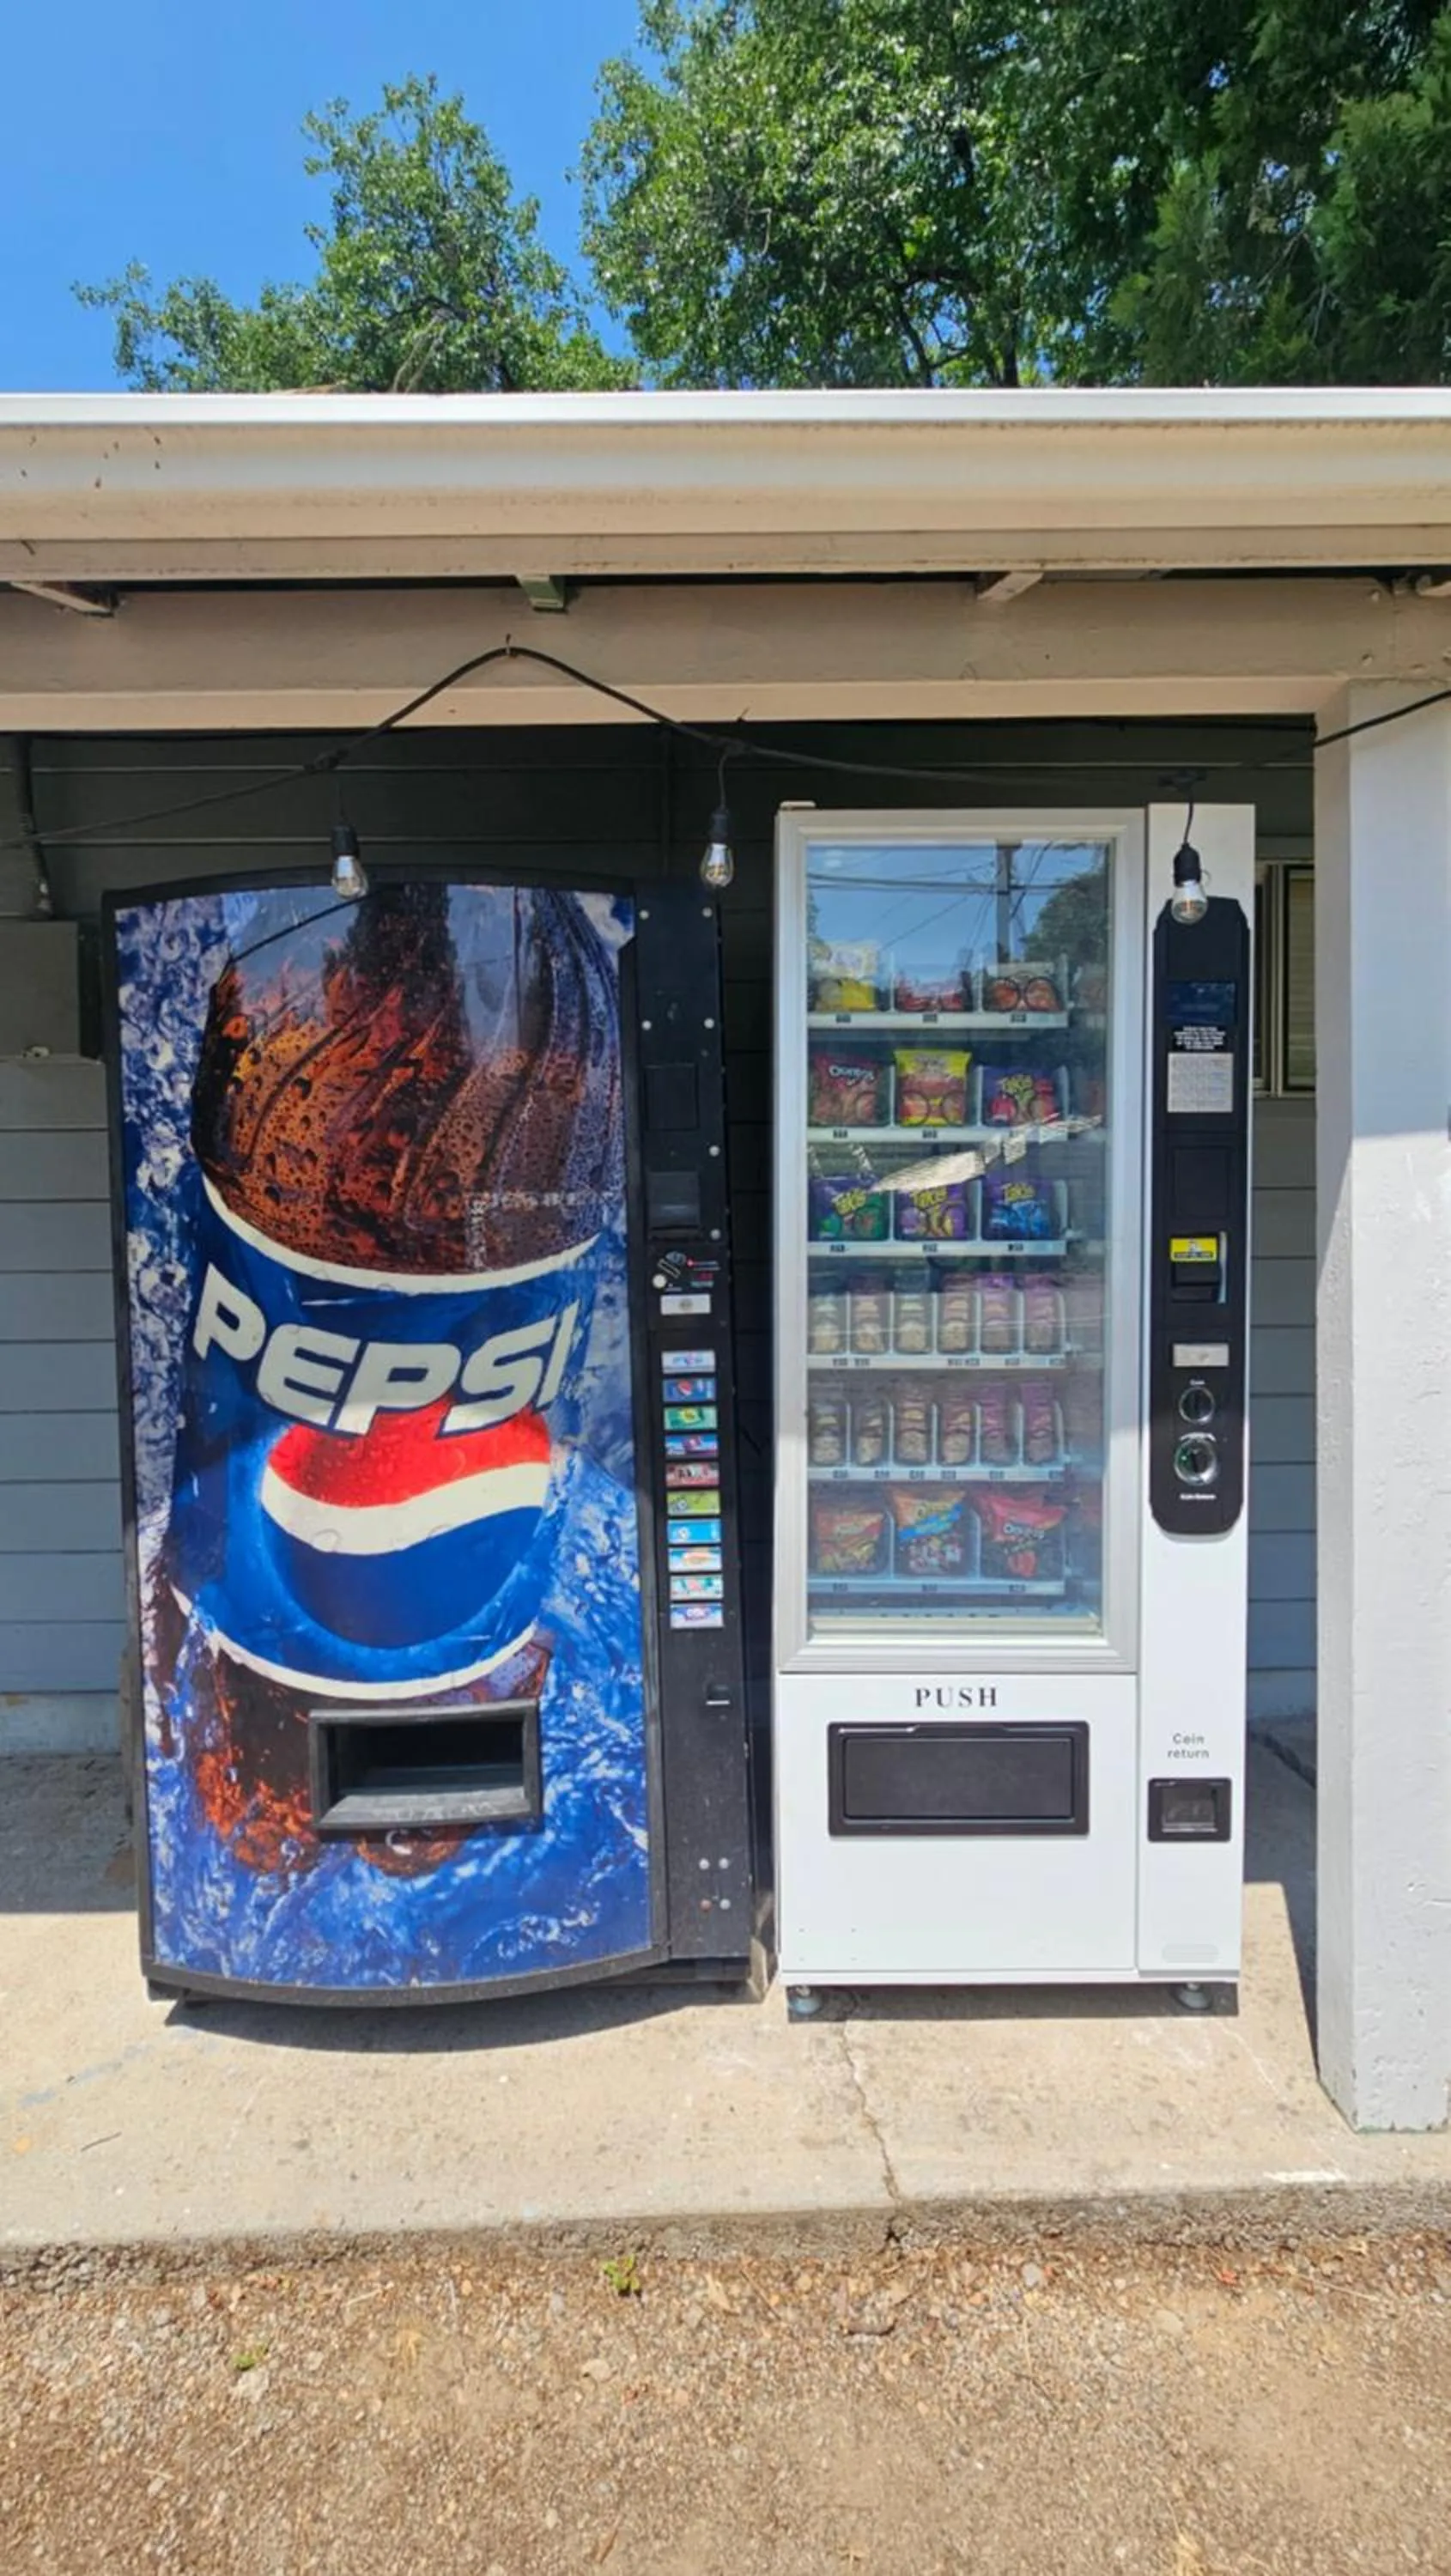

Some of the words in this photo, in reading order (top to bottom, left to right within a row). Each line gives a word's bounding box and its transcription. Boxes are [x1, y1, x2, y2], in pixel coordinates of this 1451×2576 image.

[192, 1261, 580, 1436] PEPSI
[914, 1687, 997, 1708] PUSH
[1172, 1733, 1205, 1745] Coin
[1168, 1749, 1210, 1759] return
